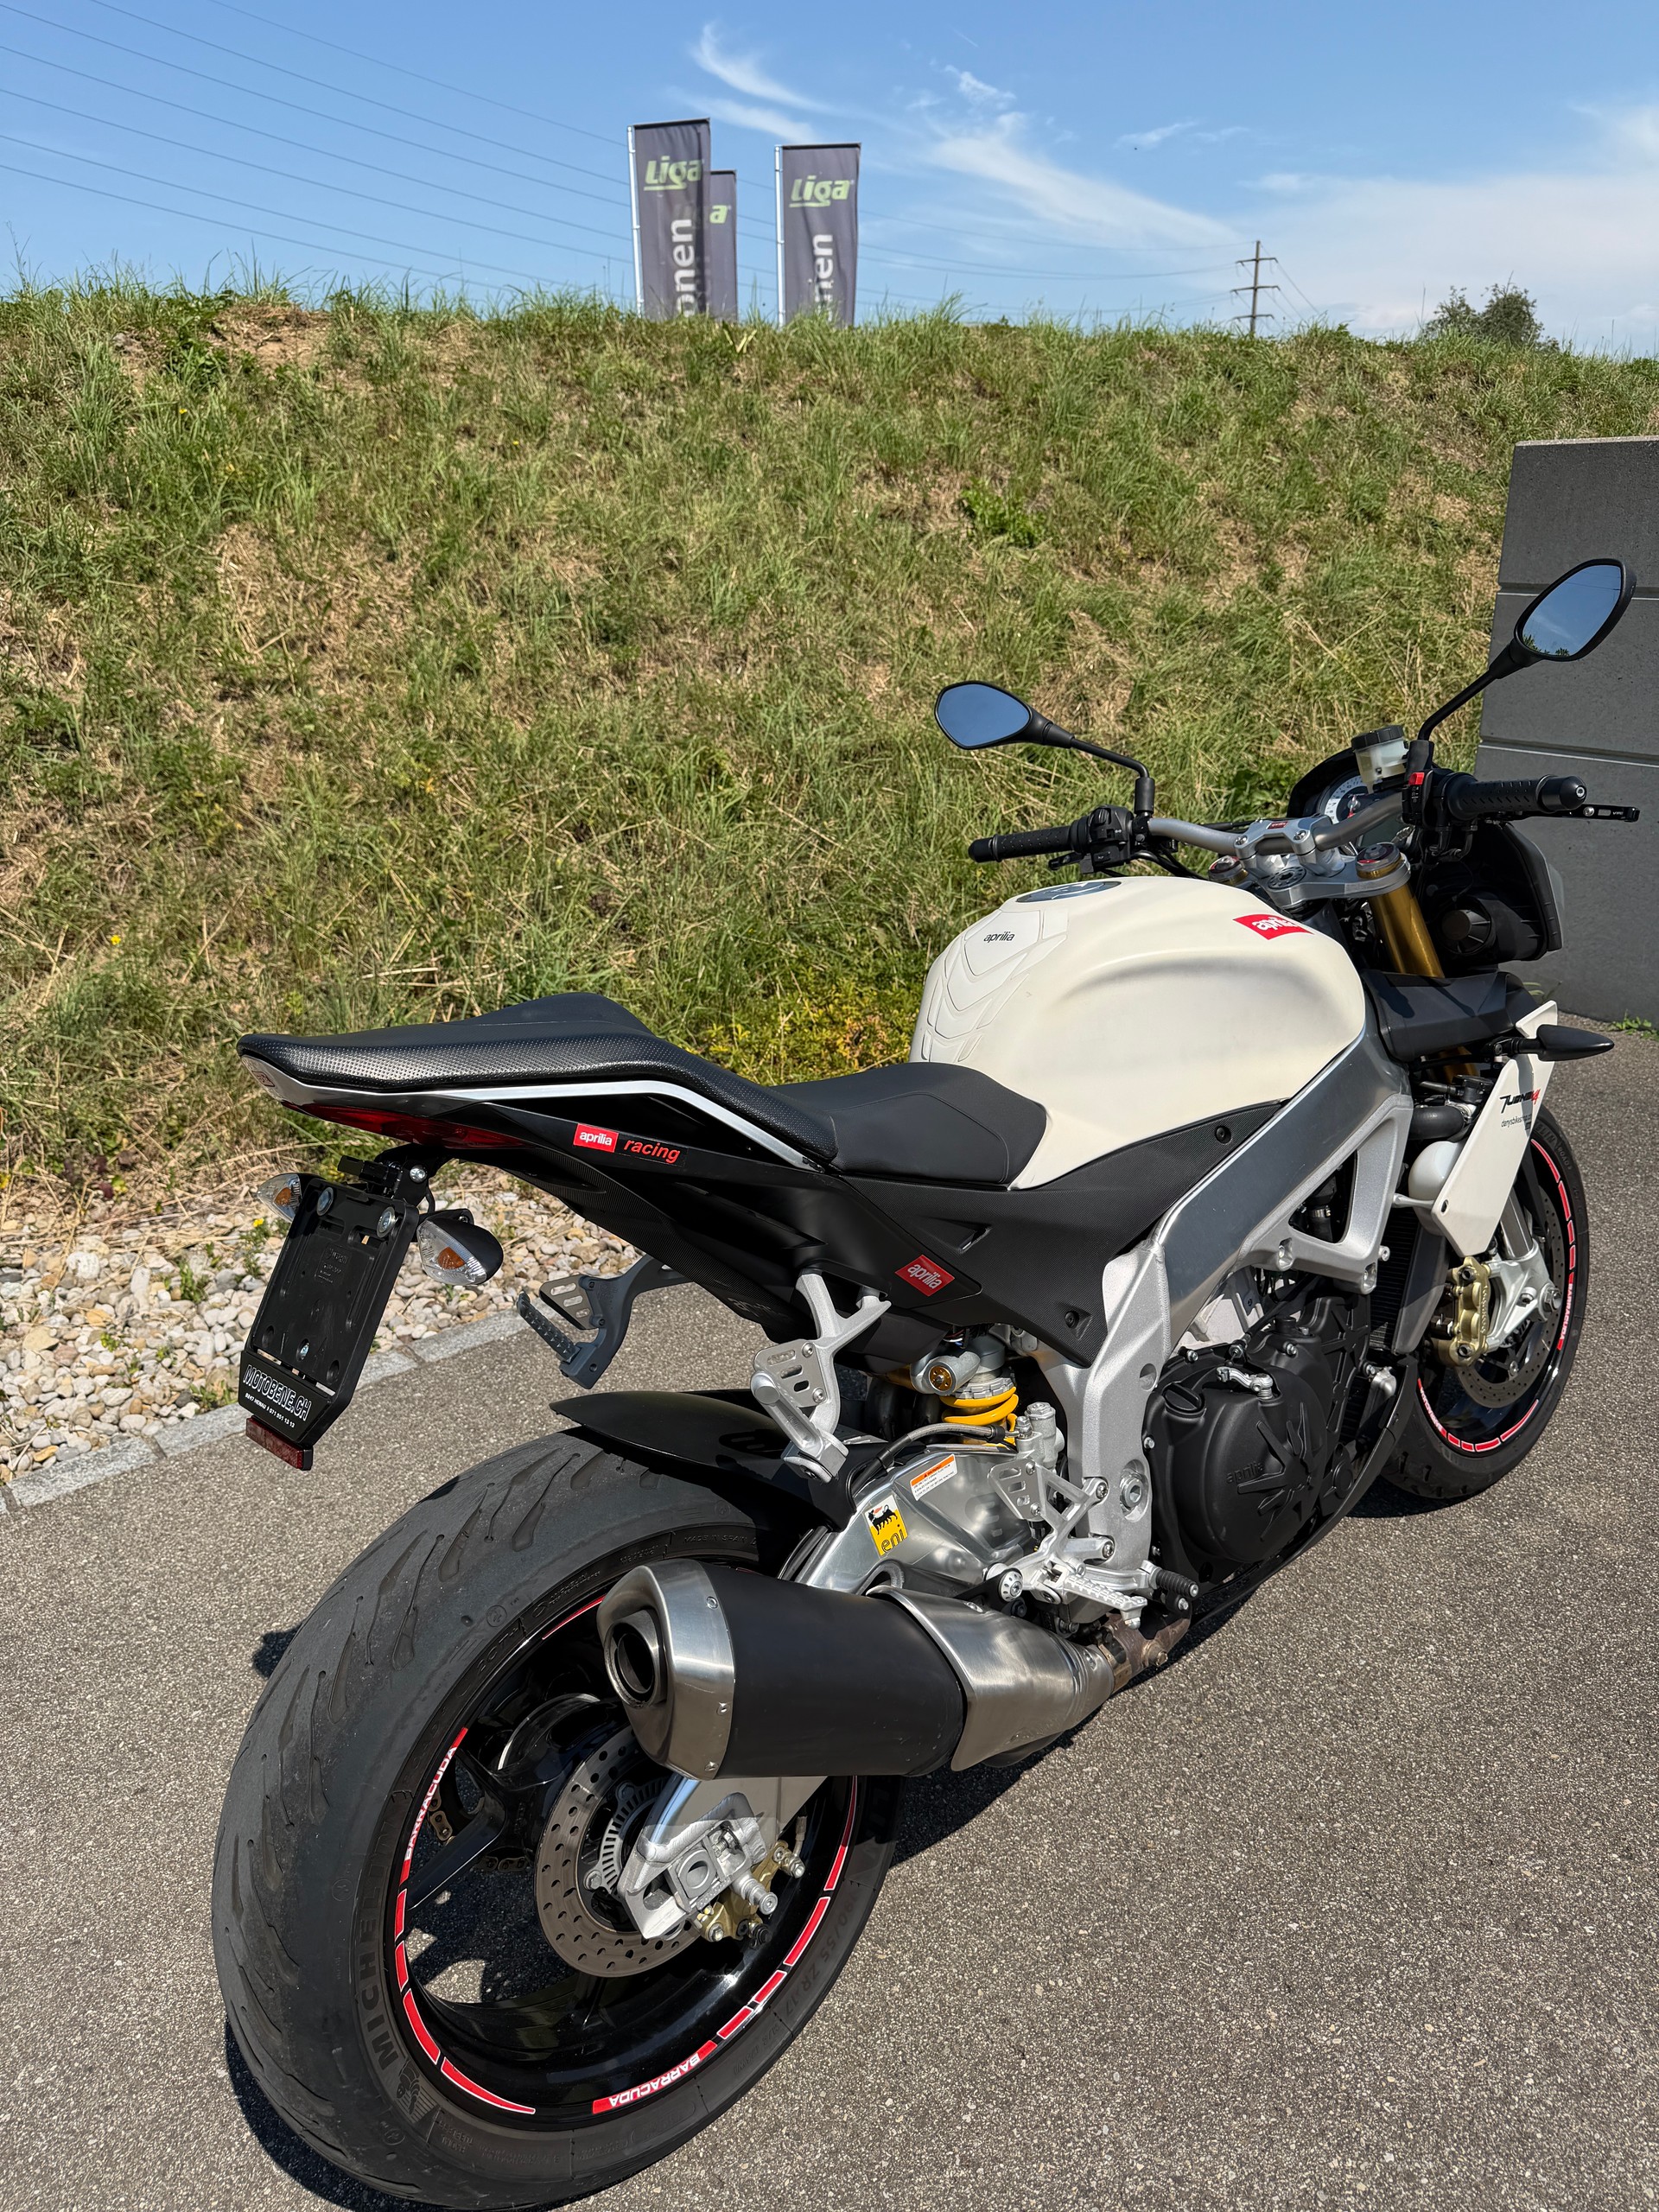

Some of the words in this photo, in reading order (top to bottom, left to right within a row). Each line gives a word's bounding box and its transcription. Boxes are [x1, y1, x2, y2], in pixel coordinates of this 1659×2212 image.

[644, 156, 702, 191] Liga
[789, 175, 851, 207] Liga
[983, 931, 1015, 944] aprilia
[579, 1131, 613, 1147] aprilia
[623, 1139, 681, 1164] racing
[907, 1263, 943, 1289] aprilia
[1559, 1283, 1573, 1339] BARRACUDA
[243, 1364, 312, 1421] MOTOBENE.CH
[1226, 1461, 1263, 1484] aprilia
[881, 1523, 905, 1554] eni
[404, 1746, 457, 1860] BARRACUDA
[359, 1819, 400, 2071] MICHELIN
[608, 2052, 701, 2107] BARRACUDA
